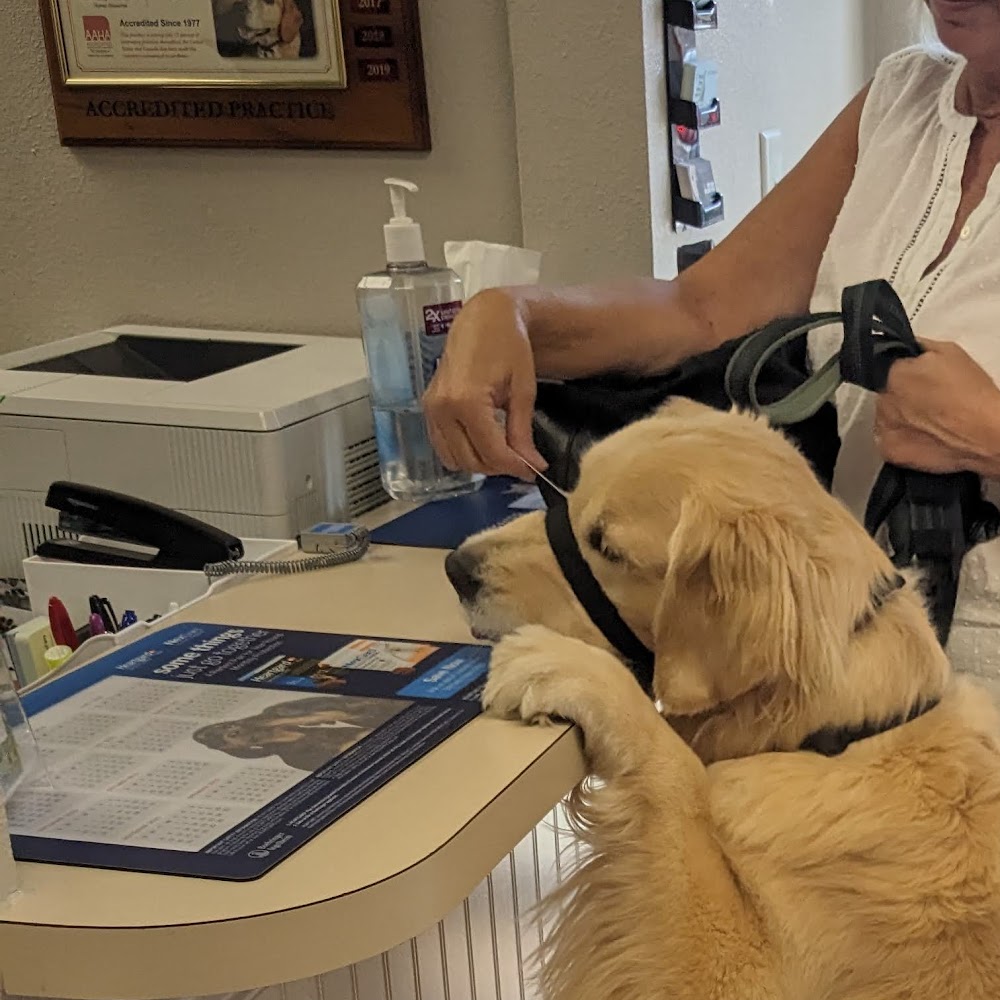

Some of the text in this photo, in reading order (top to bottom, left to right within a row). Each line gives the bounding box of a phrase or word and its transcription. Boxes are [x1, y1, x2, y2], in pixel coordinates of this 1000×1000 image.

[120, 19, 200, 27] Accredited Since 1977
[85, 29, 111, 41] AAHA
[367, 64, 391, 76] 2019
[86, 100, 335, 119] ACCREDITED PRACTICE
[153, 652, 201, 674] some
[190, 629, 245, 652] things
[201, 656, 224, 666] go
